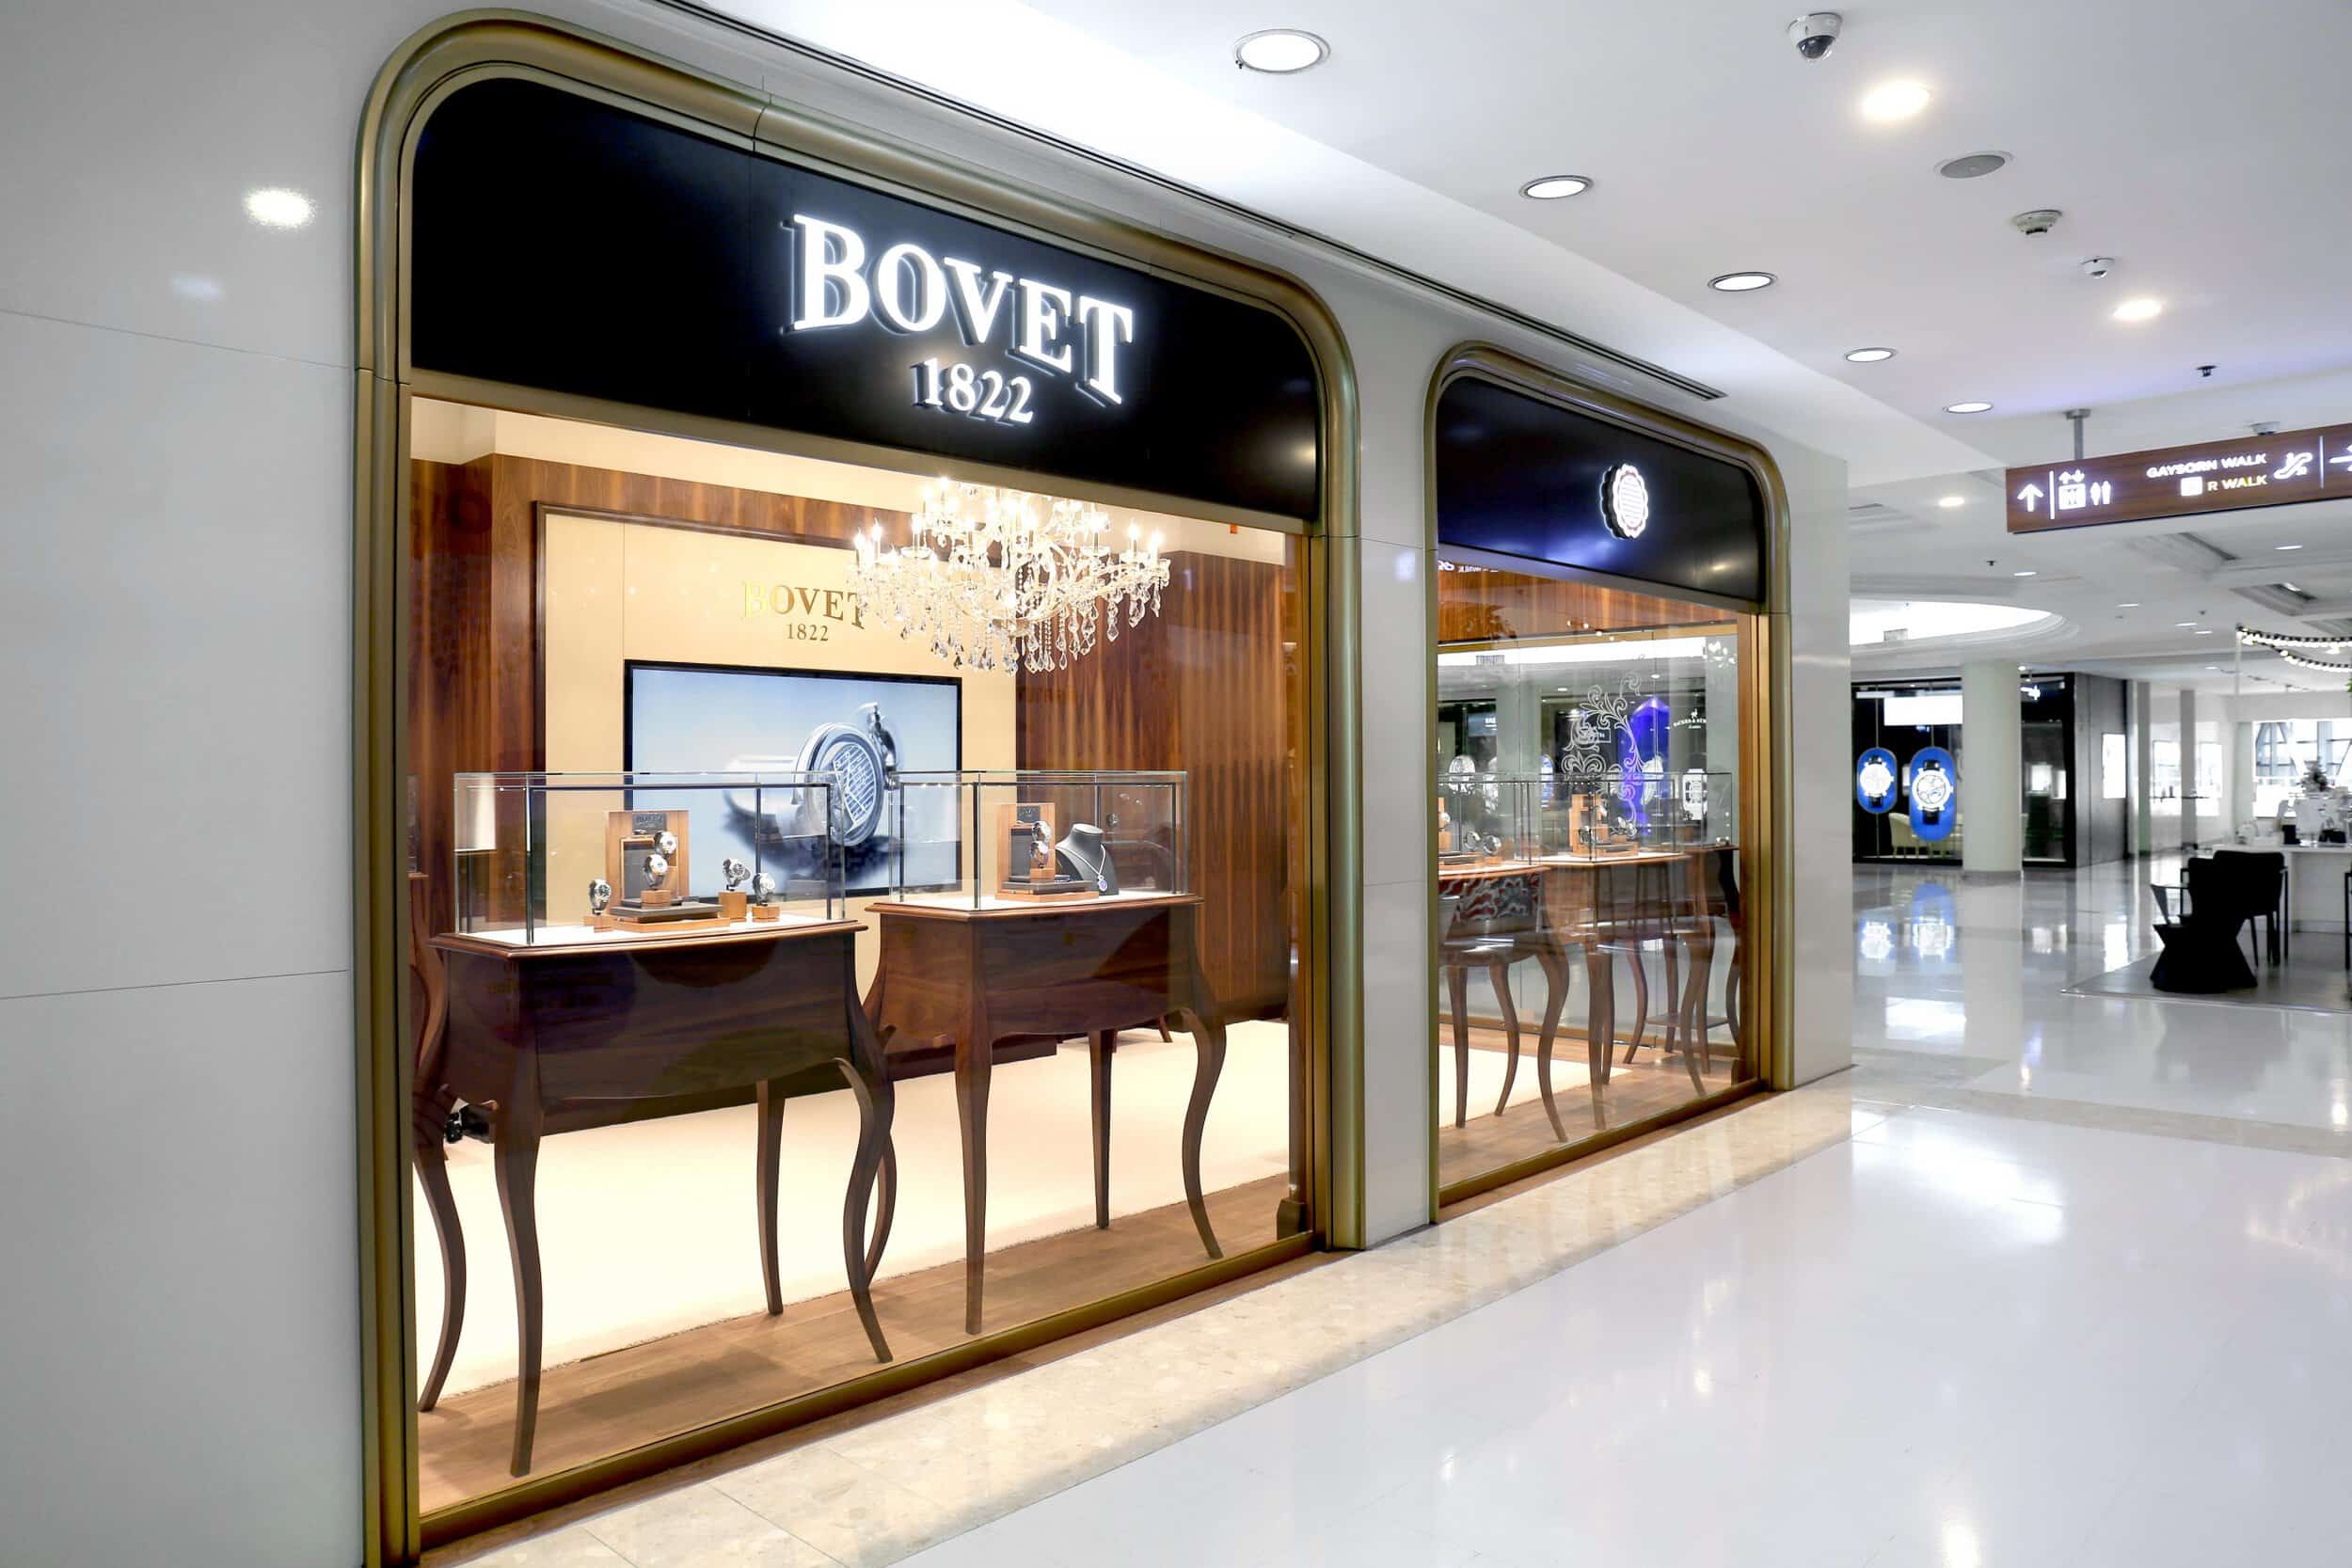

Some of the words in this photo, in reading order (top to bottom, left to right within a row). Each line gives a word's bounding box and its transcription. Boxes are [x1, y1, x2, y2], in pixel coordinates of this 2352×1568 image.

[788, 213, 1134, 405] BOVET
[921, 356, 1034, 424] 1822
[2146, 459, 2217, 478] GAYSORN
[2220, 453, 2266, 468] WALK
[2206, 481, 2218, 491] R
[2221, 474, 2267, 489] WALK
[744, 580, 866, 630] BOVET
[787, 623, 829, 641] 1822
